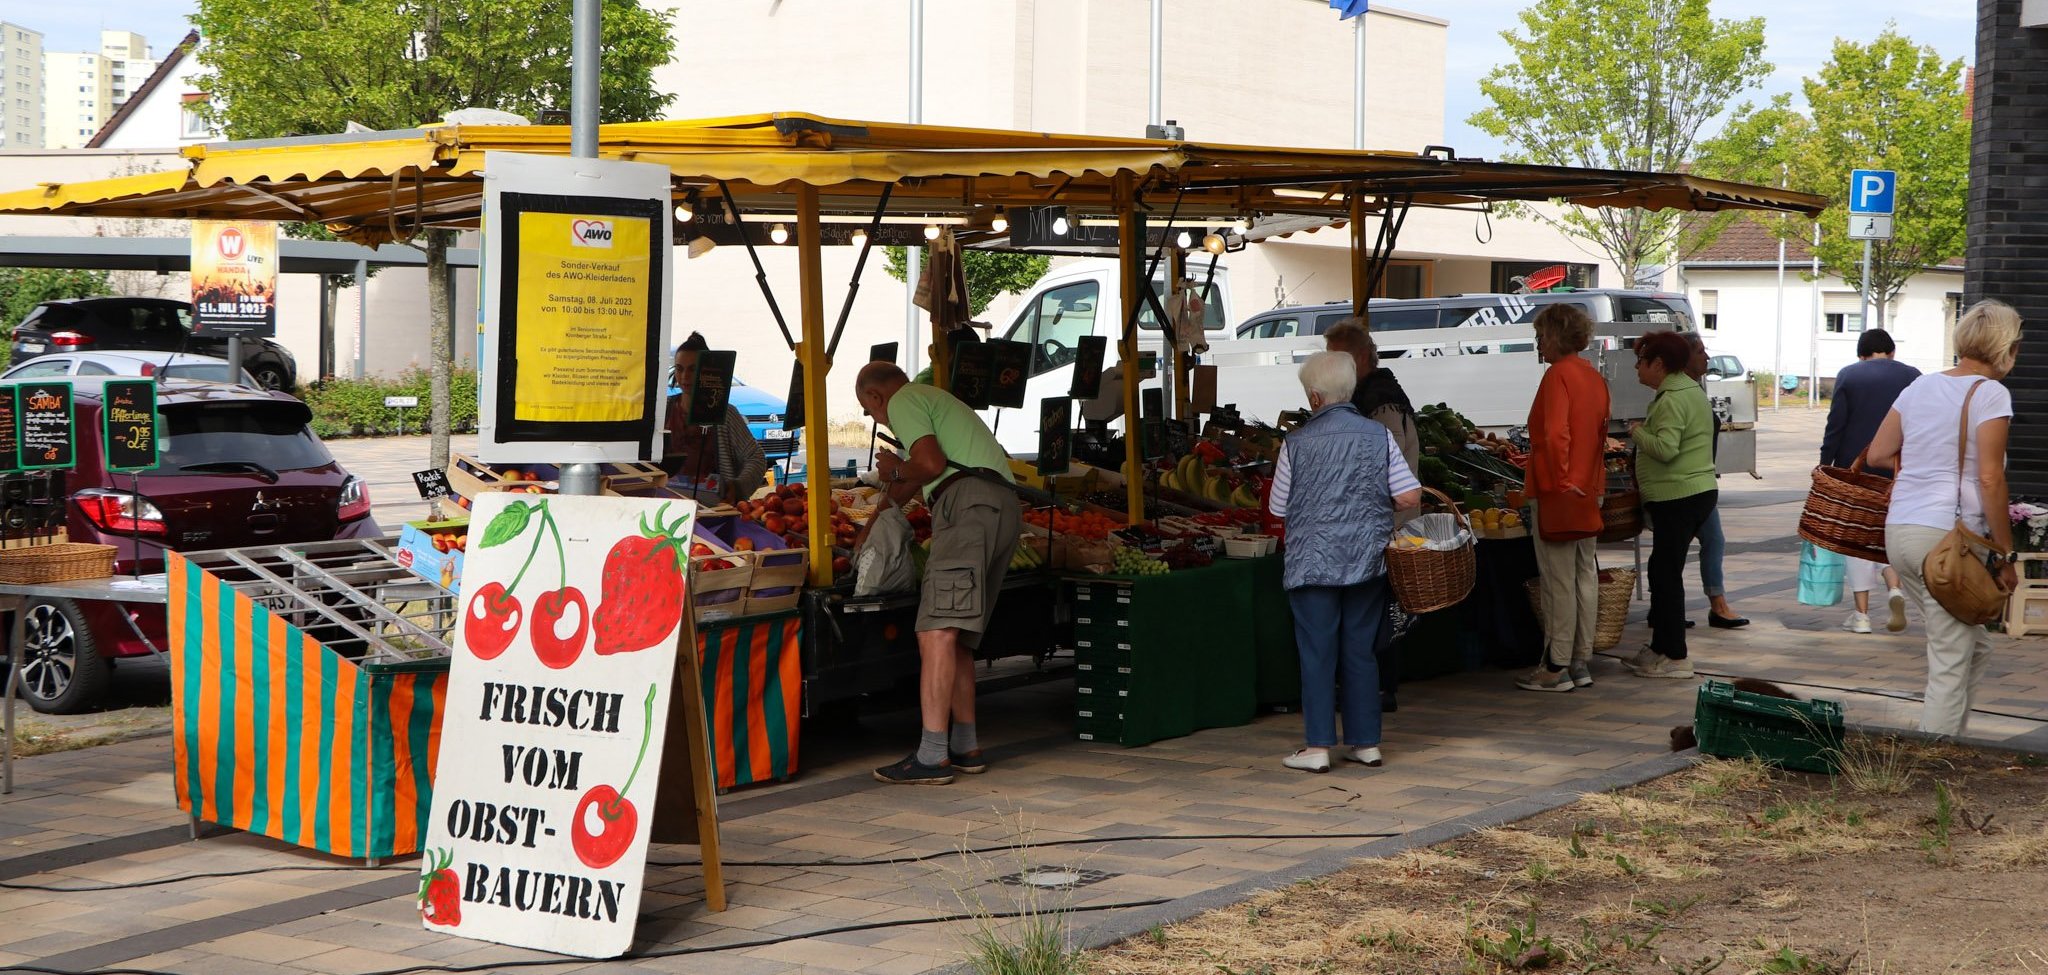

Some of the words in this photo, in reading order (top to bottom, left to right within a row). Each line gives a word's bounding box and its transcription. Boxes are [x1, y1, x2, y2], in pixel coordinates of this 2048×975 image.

[1861, 176, 1885, 207] P
[583, 228, 612, 241] AWO
[221, 235, 242, 255] W
[560, 260, 620, 272] Sonder-Verkauf
[546, 270, 561, 279] des
[563, 271, 636, 283] AWO-Kleiderladens
[239, 303, 267, 314] 2023
[587, 296, 598, 304] 08.
[600, 296, 613, 305] Juli
[615, 298, 632, 306] 2023
[562, 305, 583, 314] 10:00
[583, 306, 596, 314] bis
[597, 307, 617, 315] 13:00
[479, 682, 624, 733] FRISCH
[502, 744, 583, 790] VOM
[447, 799, 556, 848] OBST-
[462, 862, 625, 923] BAUERN
